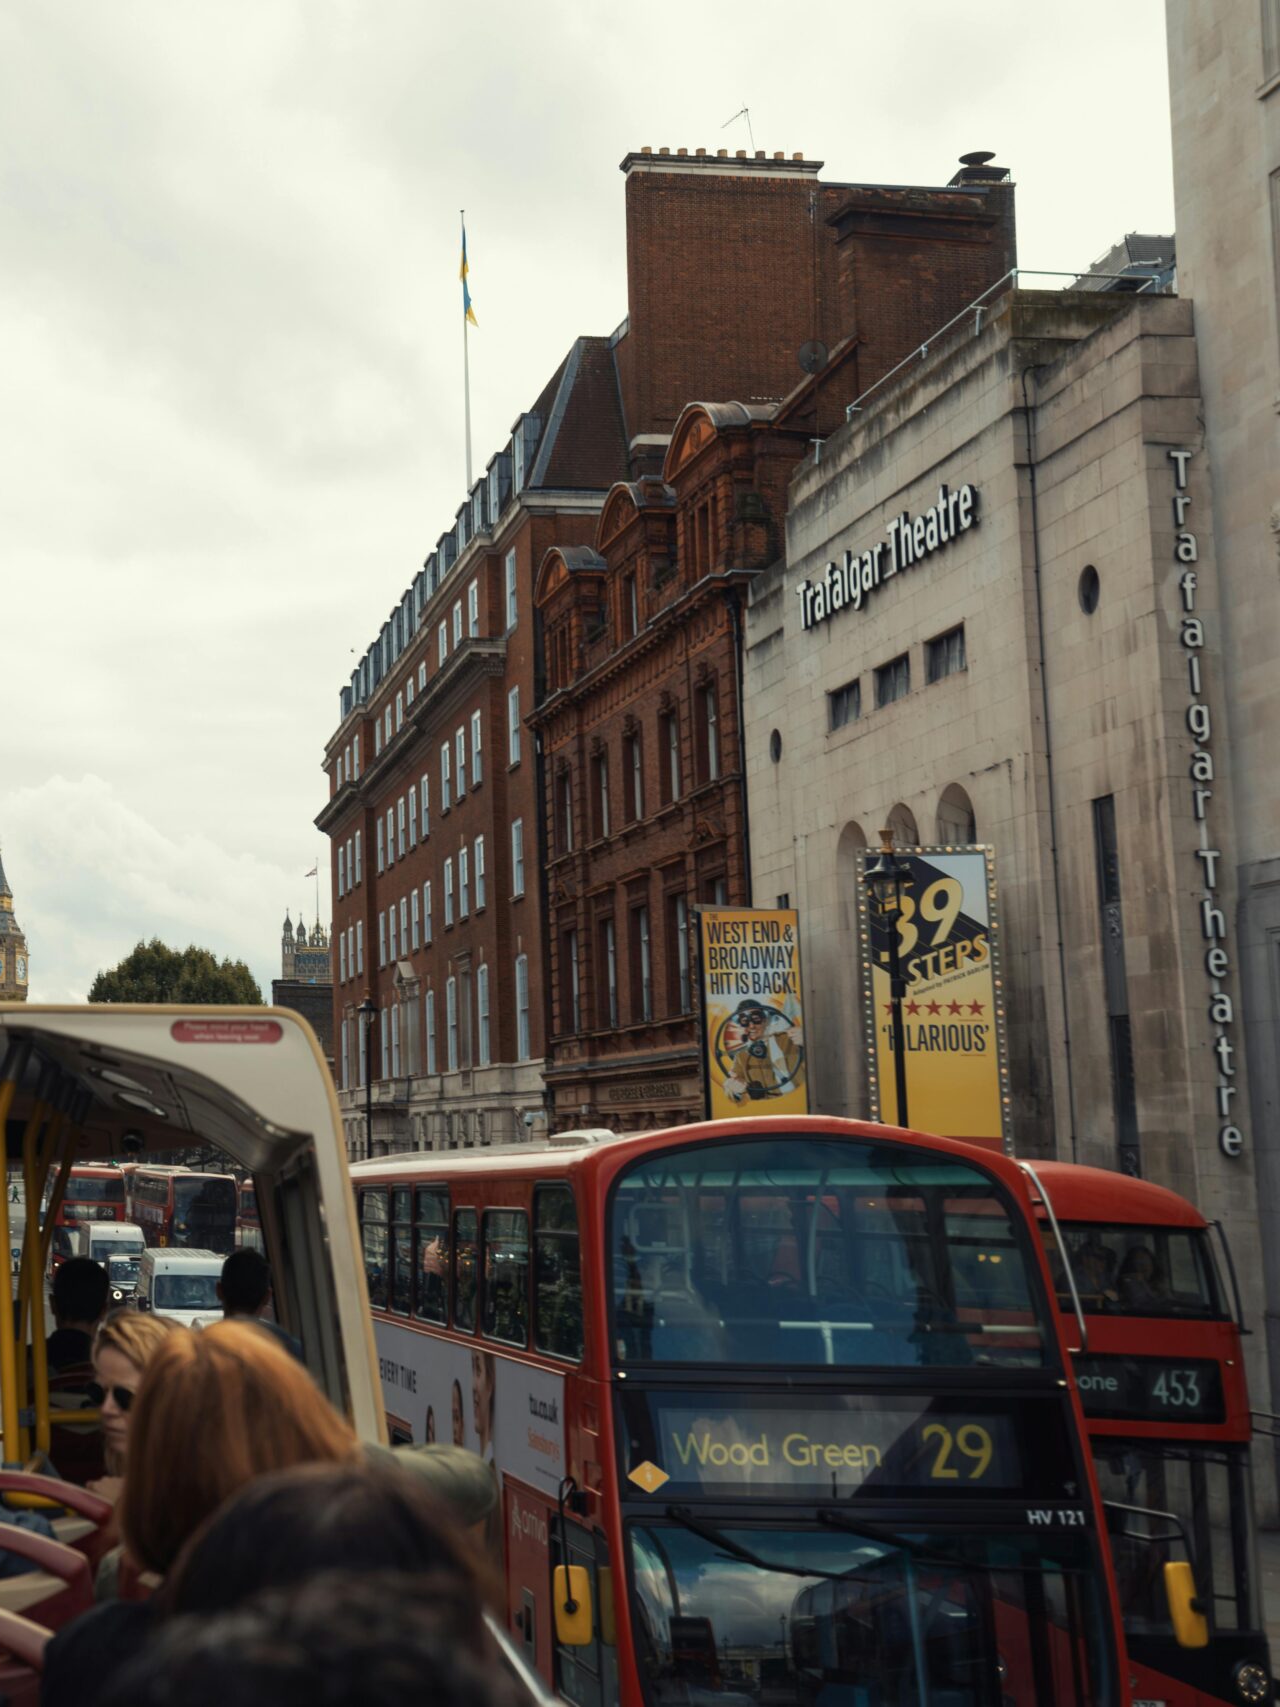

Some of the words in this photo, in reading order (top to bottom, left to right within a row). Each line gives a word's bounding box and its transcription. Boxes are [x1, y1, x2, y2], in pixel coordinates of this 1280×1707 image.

[796, 541, 886, 631] Trafalgar
[886, 484, 976, 573] Theatre
[1169, 451, 1215, 818] Trafalgar
[1197, 850, 1242, 1157] Theatre
[706, 921, 749, 944] WEST
[752, 920, 780, 943] END
[783, 923, 793, 943] &
[878, 878, 964, 962] 39
[708, 946, 794, 970] BROADWAY
[907, 934, 989, 988] STEPS
[710, 972, 733, 995] HIT
[735, 972, 750, 994] IS
[752, 971, 797, 994] BACK!
[379, 1358, 400, 1386] EVERY
[400, 1365, 418, 1394] TIME
[1152, 1370, 1201, 1407] 453
[671, 1432, 769, 1466] Wood
[782, 1433, 882, 1468] Green
[922, 1423, 993, 1480] 29
[1027, 1510, 1053, 1525] HV
[1057, 1510, 1085, 1525] 121
